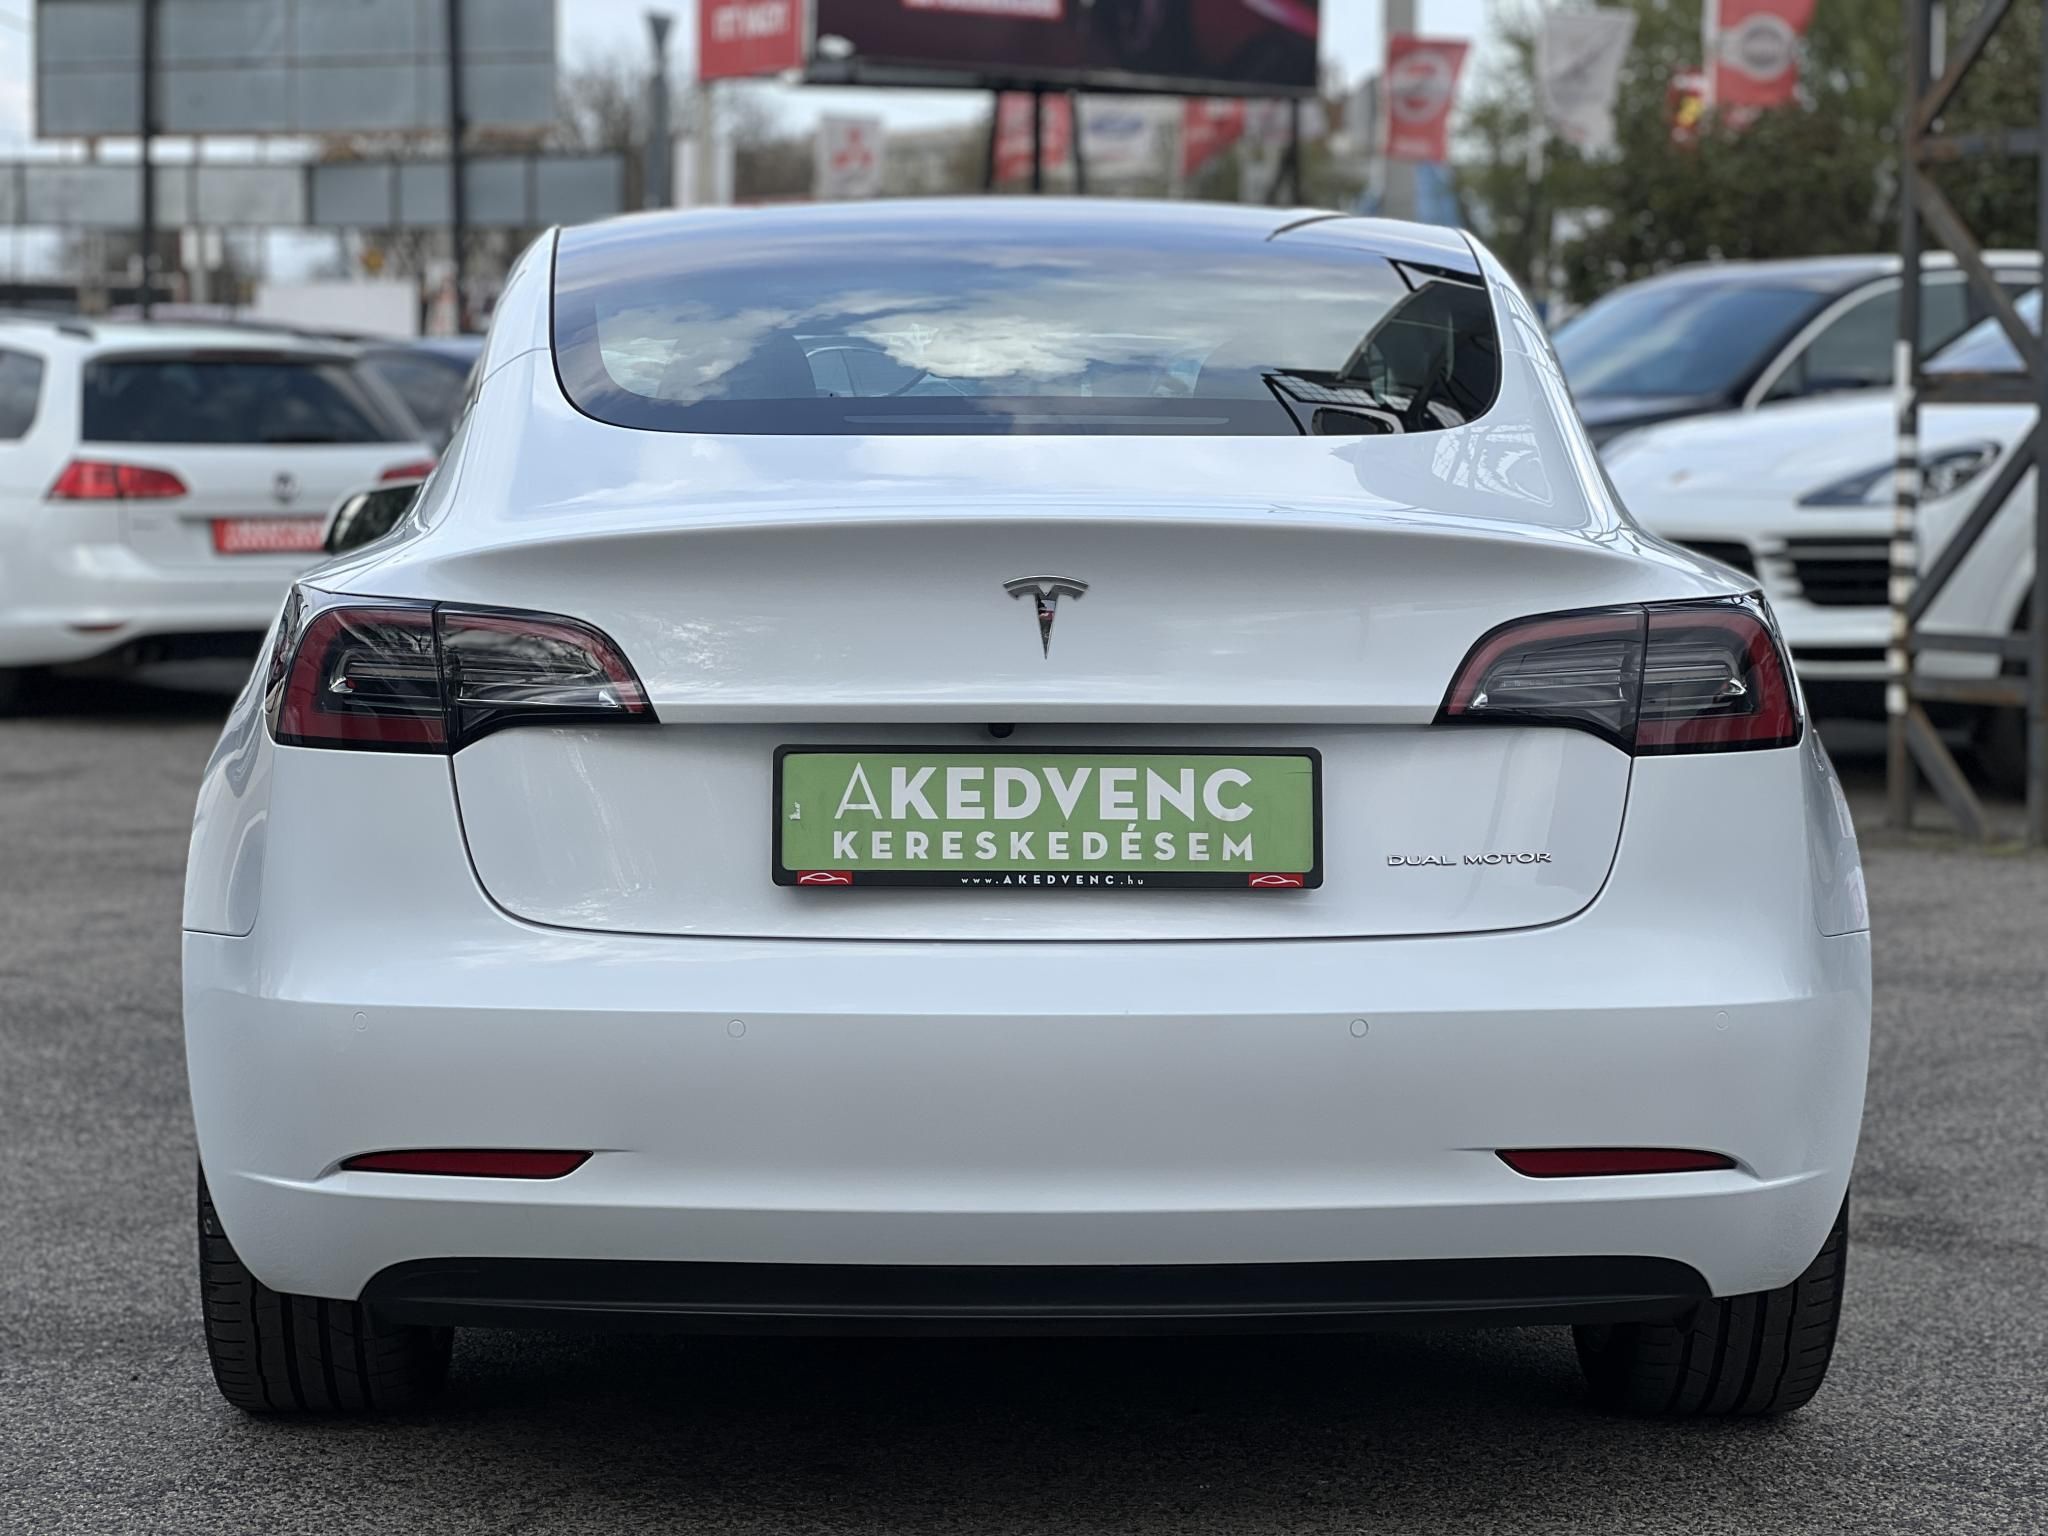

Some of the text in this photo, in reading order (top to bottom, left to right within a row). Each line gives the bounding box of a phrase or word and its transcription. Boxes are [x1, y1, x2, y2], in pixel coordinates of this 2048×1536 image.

[834, 762, 1254, 822] AKEDVENC
[833, 824, 1253, 861] KERESKEDÉSEM
[1387, 852, 1552, 866] DUAL MOTOR
[962, 875, 1144, 886] www.AKEDVENC.hu
